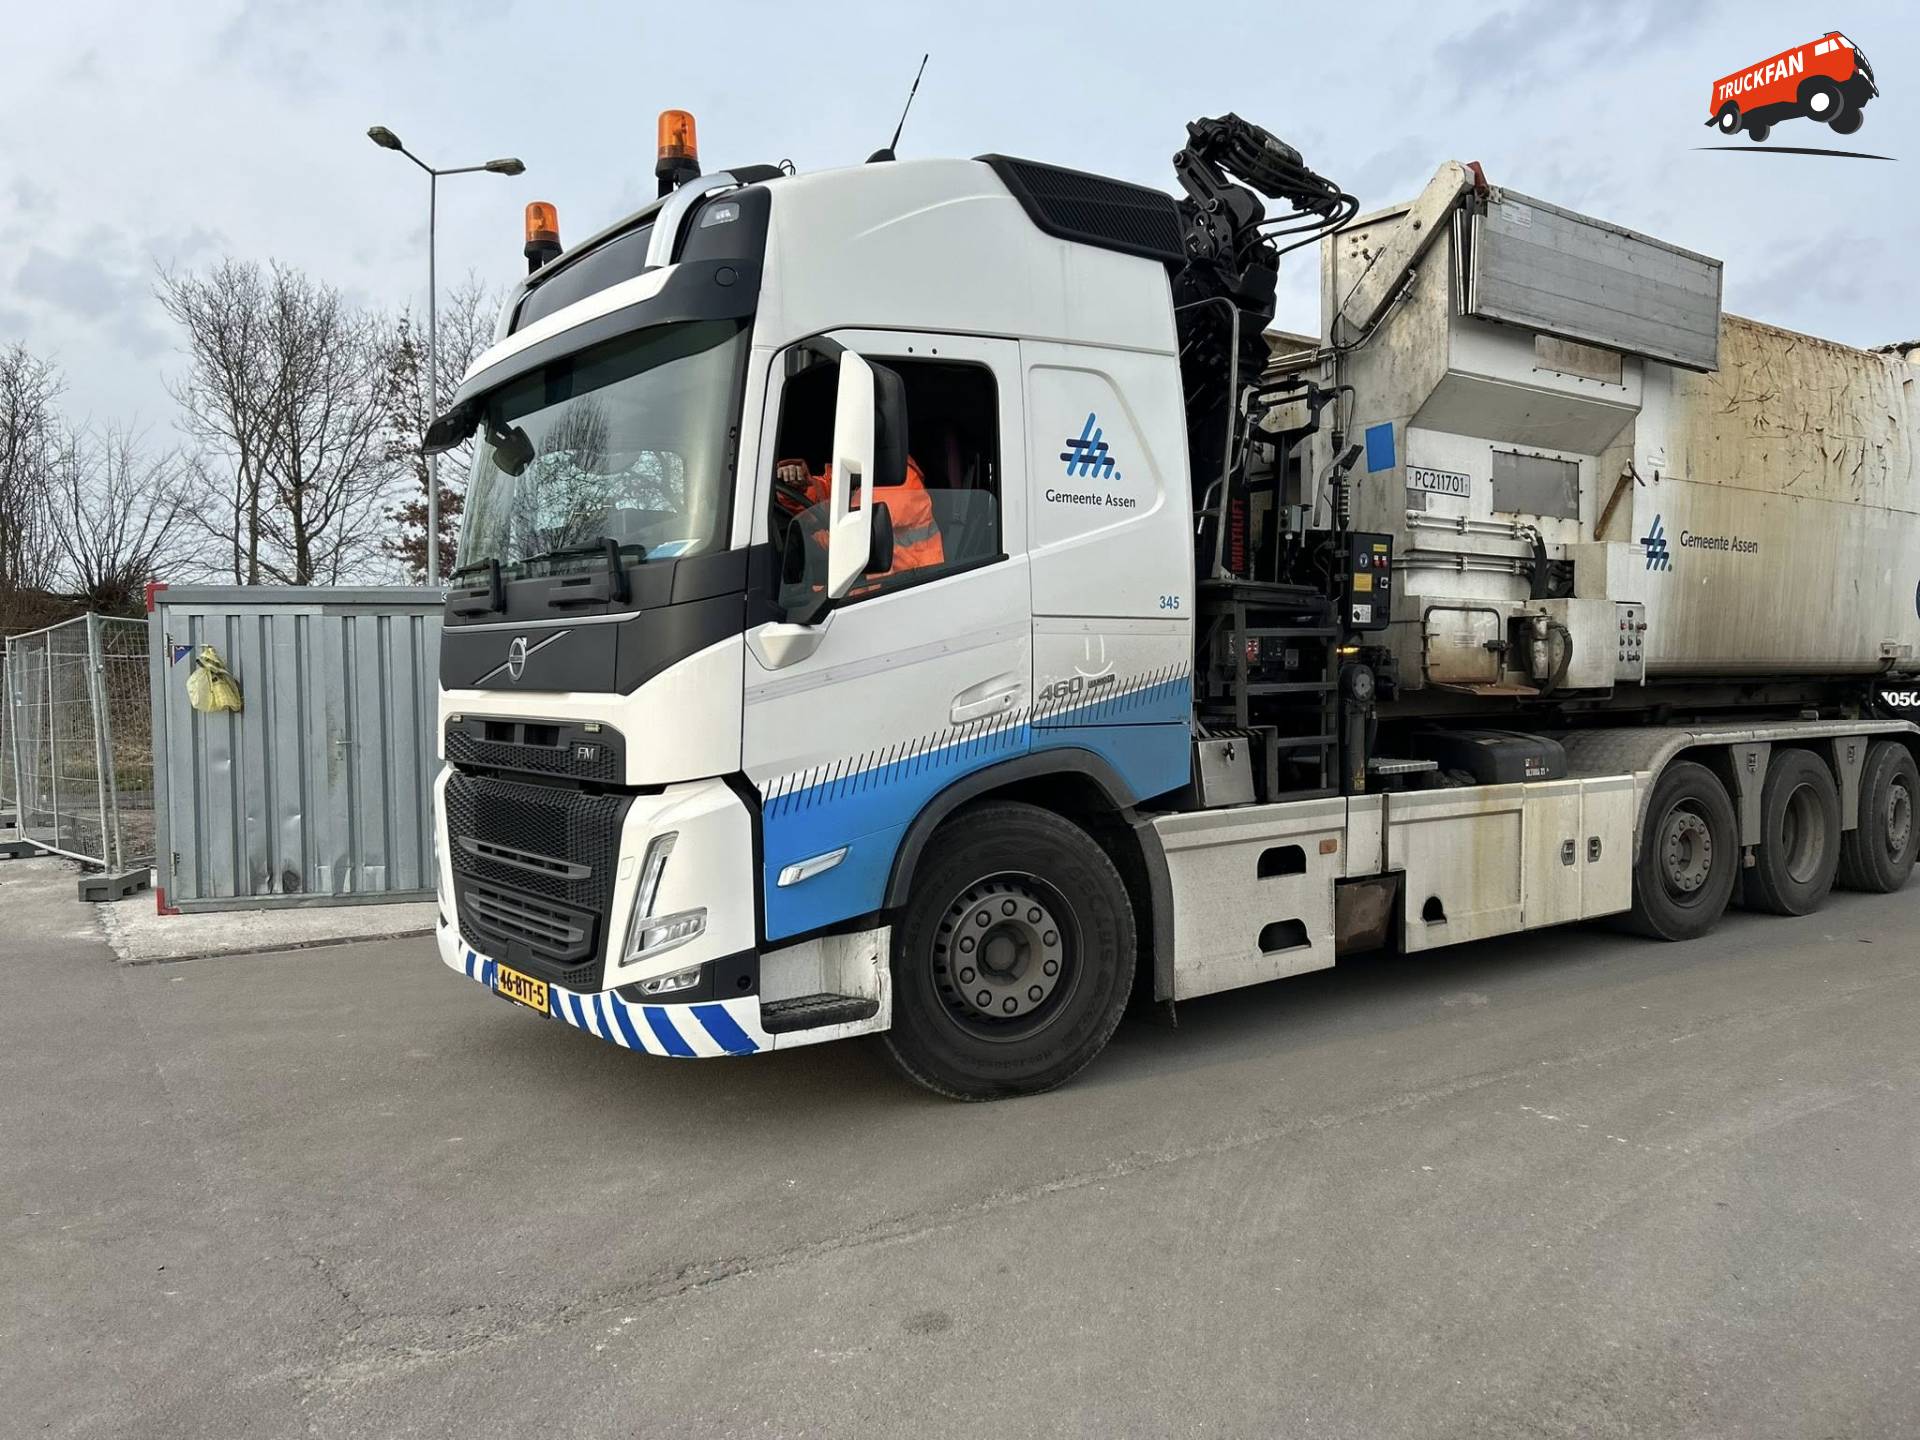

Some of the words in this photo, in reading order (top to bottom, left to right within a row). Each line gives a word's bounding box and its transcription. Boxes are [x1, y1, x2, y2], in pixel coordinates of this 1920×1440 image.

[1415, 470, 1464, 493] PC211701
[1045, 488, 1102, 506] Gemeente
[1105, 493, 1136, 508] Assen
[1231, 498, 1244, 571] MULTILIFT
[1680, 530, 1729, 551] Gemeente
[1731, 535, 1758, 554] Assen
[1159, 595, 1180, 610] 345
[1038, 676, 1084, 701] 460
[577, 746, 595, 760] FM
[500, 969, 545, 1006] 46-BTT-5
